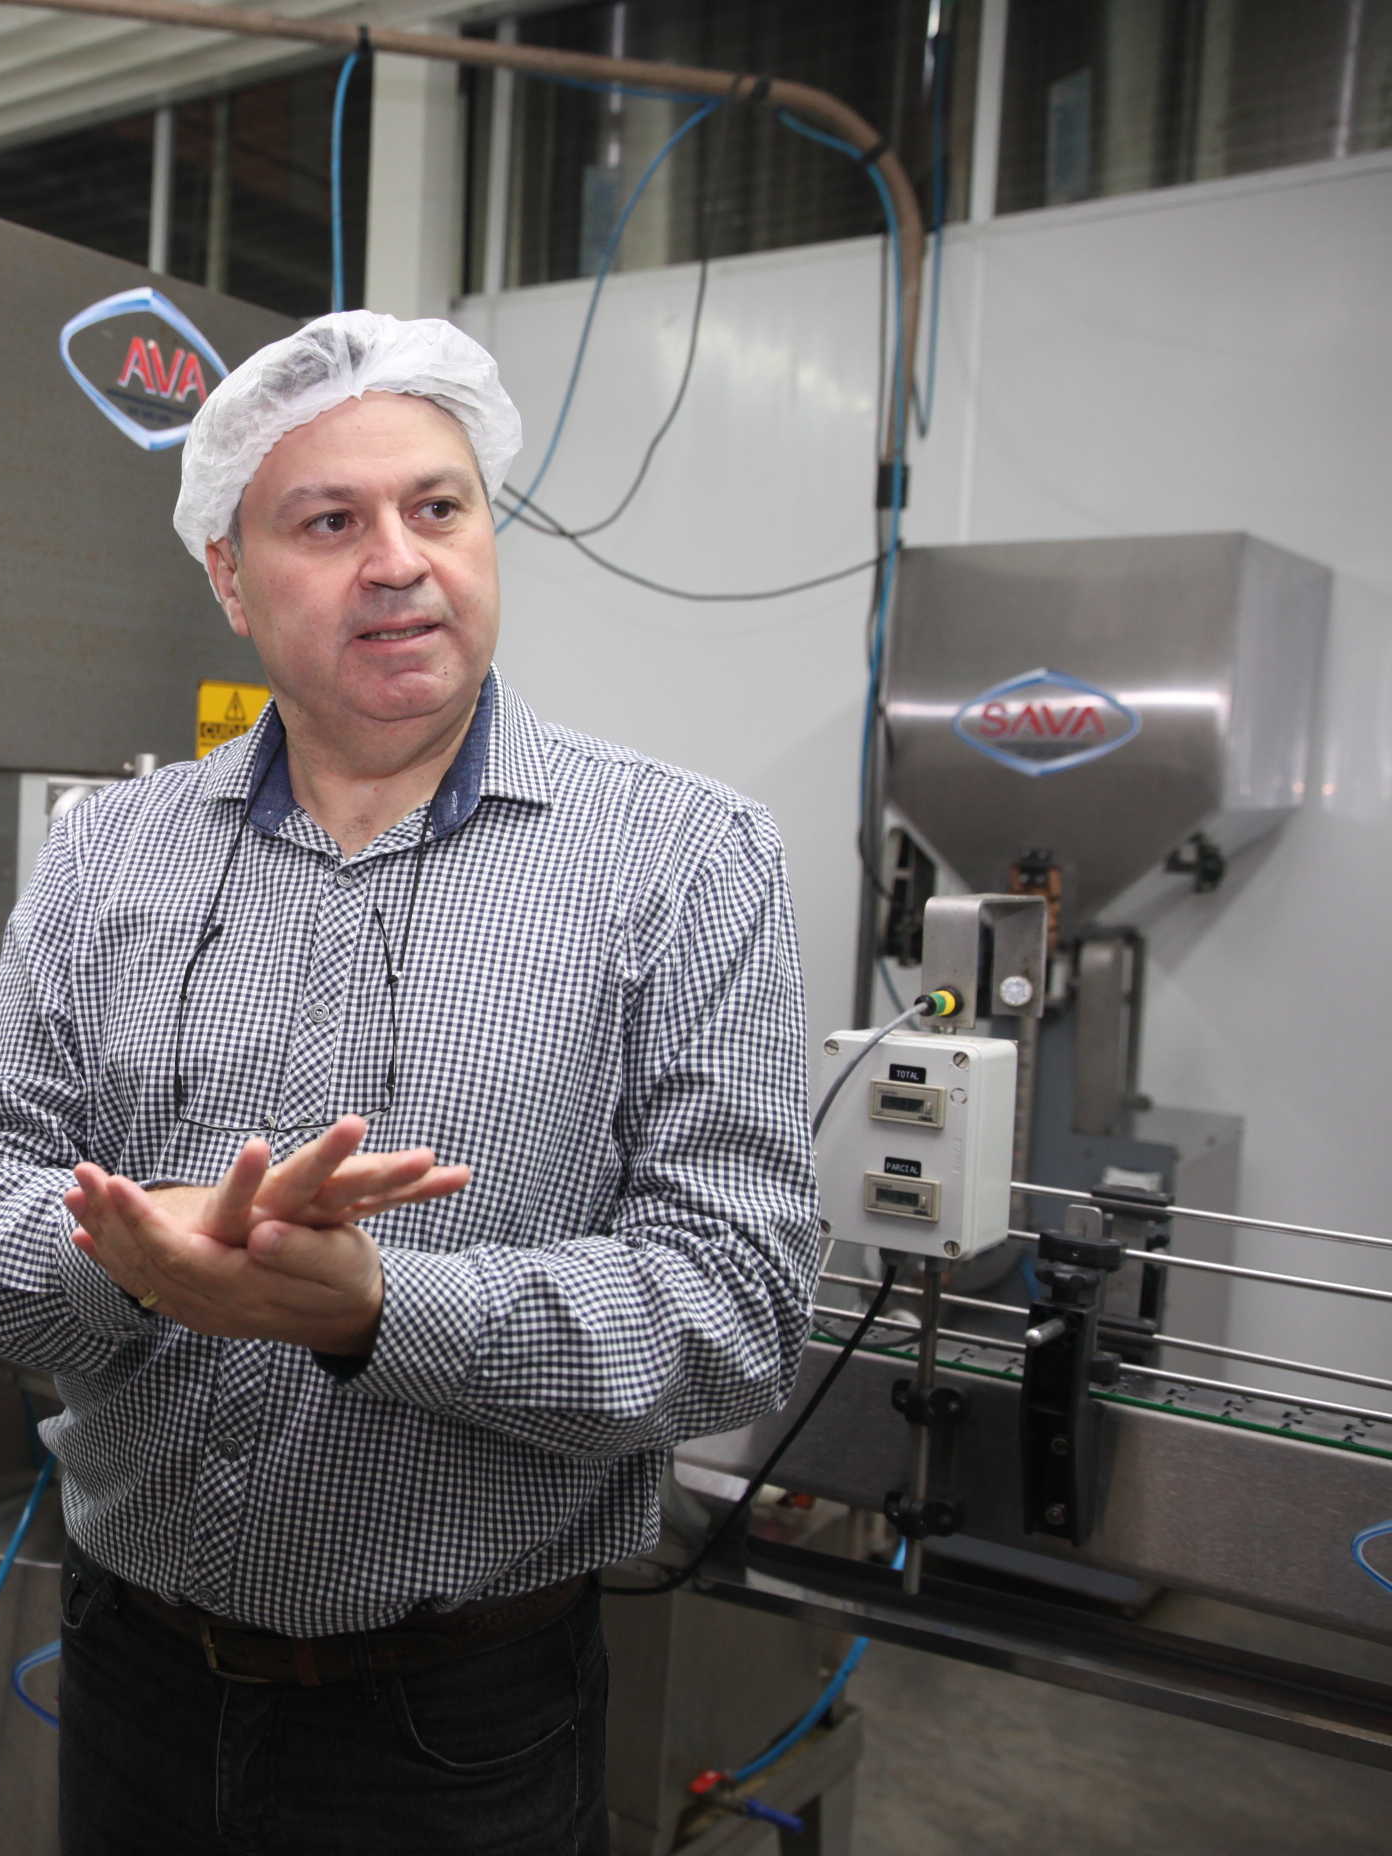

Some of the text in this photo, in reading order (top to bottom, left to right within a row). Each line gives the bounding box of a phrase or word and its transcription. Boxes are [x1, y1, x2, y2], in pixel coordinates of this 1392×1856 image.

[979, 702, 1107, 740] SAVA
[896, 1069, 920, 1081] TOTAL
[886, 1161, 919, 1175] PARCIAL
